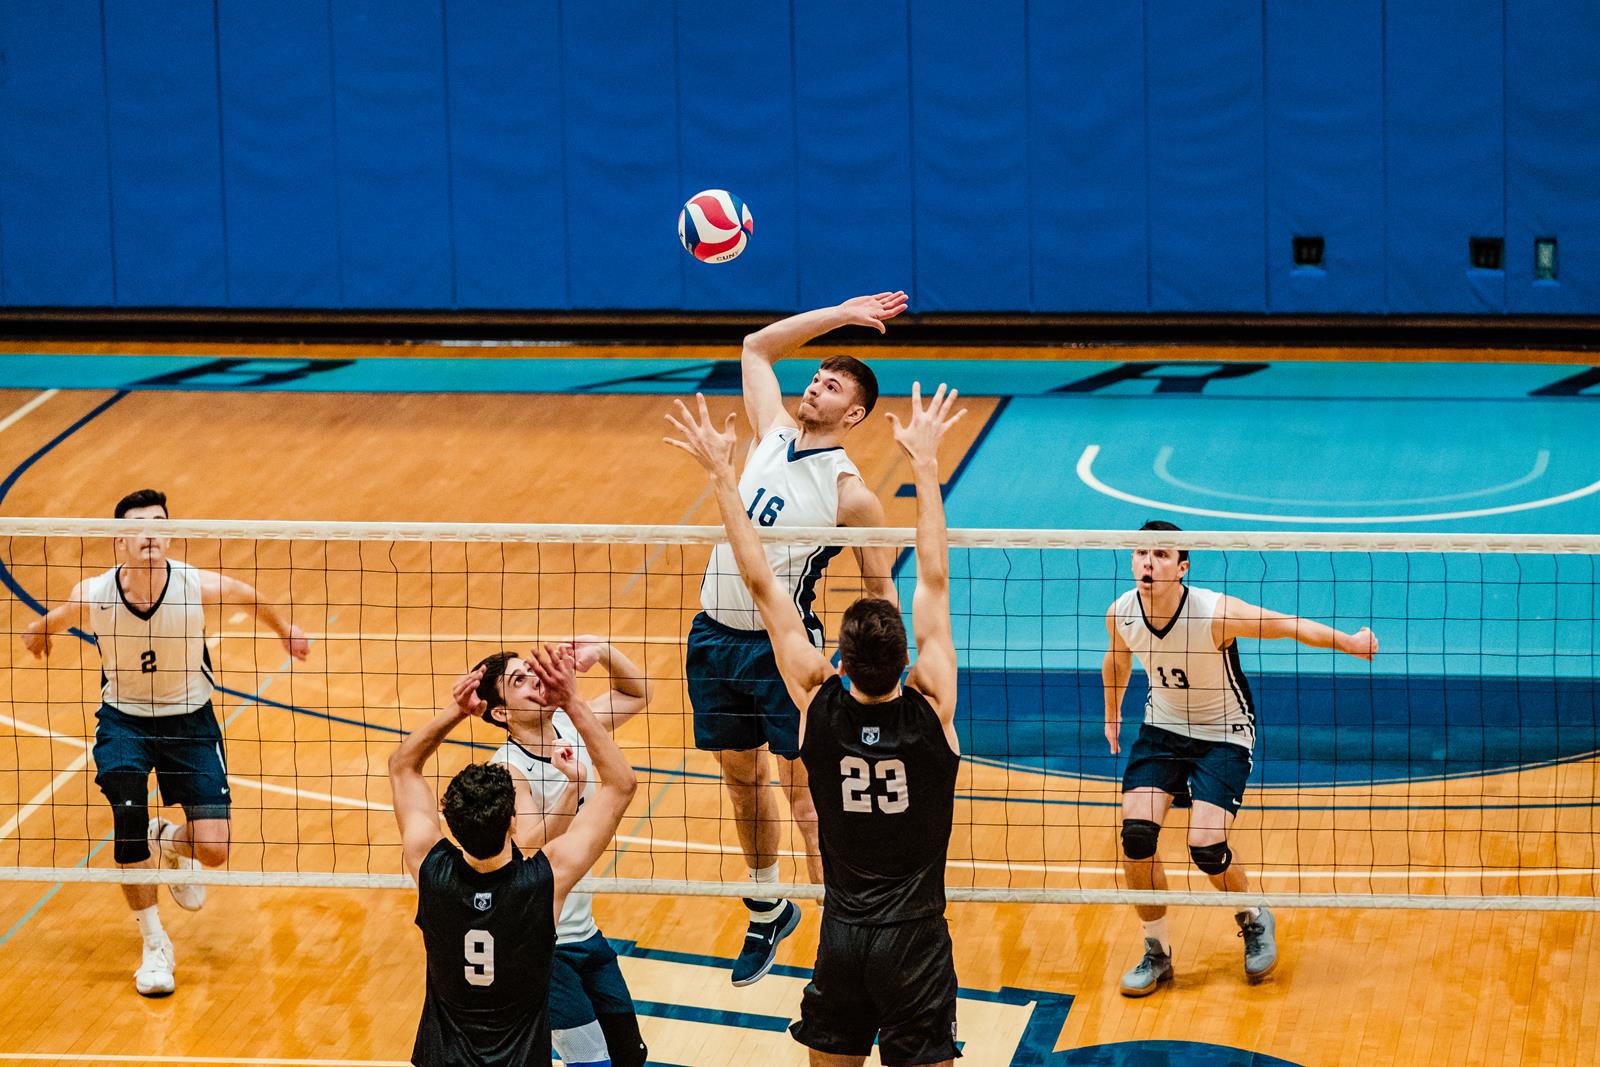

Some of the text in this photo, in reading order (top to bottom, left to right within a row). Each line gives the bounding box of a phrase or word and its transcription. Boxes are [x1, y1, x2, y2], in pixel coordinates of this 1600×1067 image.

[746, 487, 785, 527] 16
[141, 650, 157, 674] 2
[1157, 666, 1190, 689] 13
[840, 755, 909, 814] 23
[464, 929, 495, 987] 9
